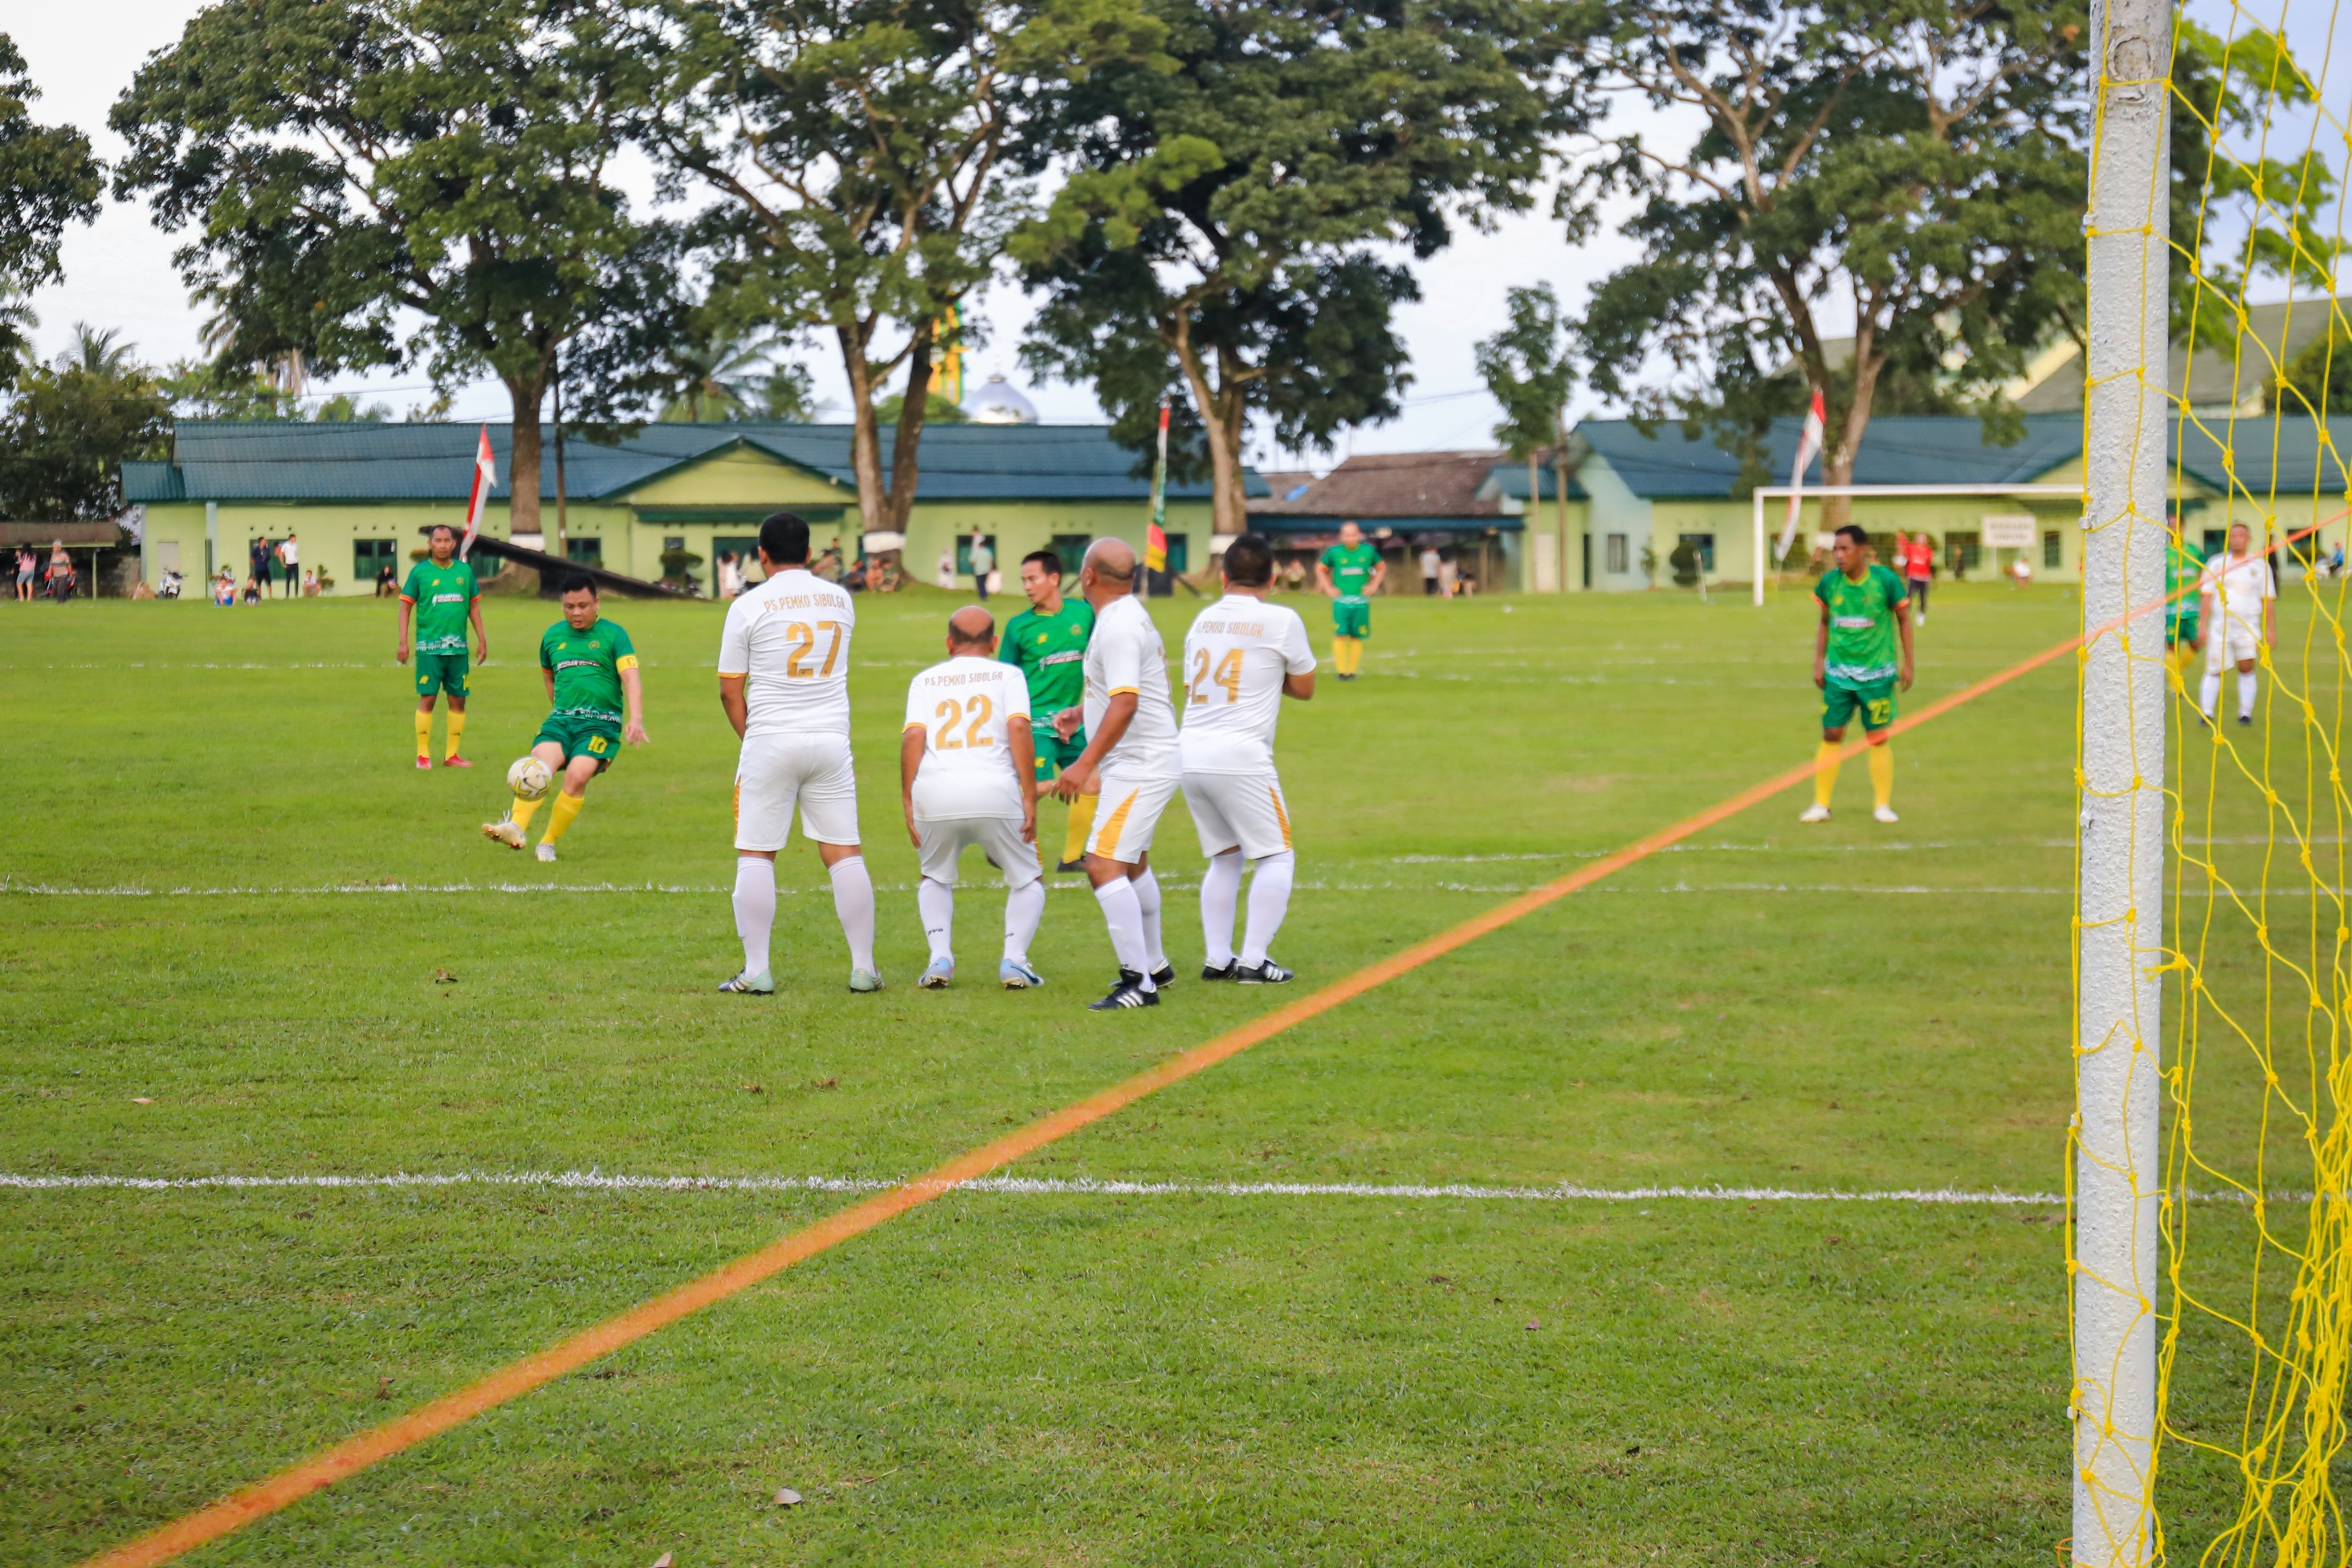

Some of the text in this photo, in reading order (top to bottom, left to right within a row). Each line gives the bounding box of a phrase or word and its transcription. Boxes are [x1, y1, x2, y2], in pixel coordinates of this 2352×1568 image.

[813, 593, 846, 609] SIBOLGA
[786, 620, 842, 678] 27
[626, 657, 637, 667] C
[968, 671, 1003, 683] SIBOLGA
[1192, 648, 1245, 705] 24
[936, 694, 995, 751] 22
[1867, 697, 1890, 725] 23
[588, 735, 608, 754] 10
